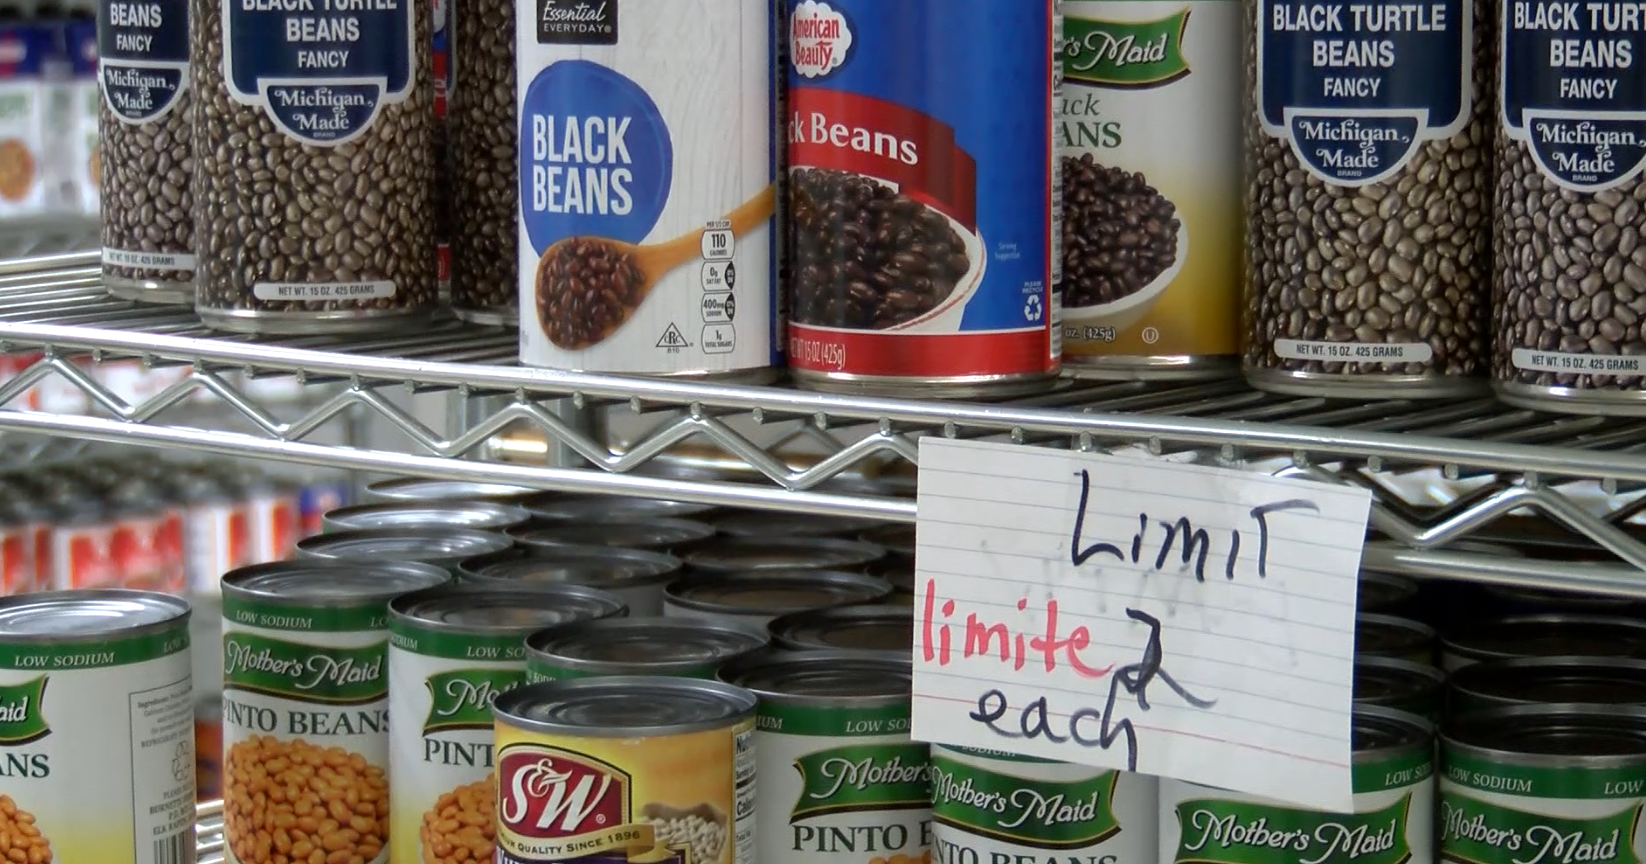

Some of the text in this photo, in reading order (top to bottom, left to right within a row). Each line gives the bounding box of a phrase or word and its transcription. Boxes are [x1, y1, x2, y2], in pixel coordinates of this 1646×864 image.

[110, 3, 161, 28] BEANS
[543, 1, 607, 22] Essential
[1273, 4, 1447, 31] BLACK TURTLE
[1514, 2, 1579, 30] BLACK
[286, 18, 360, 41] BEANS
[793, 12, 840, 39] American
[117, 34, 152, 52] FANCY
[795, 41, 833, 70] Beauty
[1073, 31, 1168, 71] Maid
[1313, 40, 1395, 67] BEANS
[1550, 39, 1632, 68] BEANS
[298, 51, 349, 68] FANCY
[106, 68, 175, 96] Michigan
[1324, 78, 1381, 98] FANCY
[1560, 78, 1618, 99] FANCY
[114, 92, 153, 110] Made
[274, 87, 374, 113] Michigan
[293, 113, 349, 130] Made
[533, 114, 634, 165] BLACK
[811, 112, 918, 166] Beans
[1299, 120, 1409, 151] Michigan
[1536, 121, 1646, 152] Michigan
[1316, 146, 1379, 169] Made
[1552, 150, 1615, 173] Made
[533, 165, 635, 216] BEANS
[711, 233, 726, 248] 110
[278, 287, 292, 296] NET
[310, 286, 319, 296] 15
[335, 286, 348, 295] 425
[349, 285, 375, 295] GRAMS
[1083, 326, 1116, 342] (425g)
[821, 342, 846, 370] (425g)
[1296, 344, 1310, 354] NET
[1311, 345, 1325, 355] WT.
[1328, 345, 1337, 356] 15
[1355, 346, 1371, 357] 425
[1372, 346, 1403, 357] GRAMS
[1532, 354, 1545, 365] NET
[1546, 355, 1560, 368] WT.
[1562, 356, 1571, 368] 15
[1589, 358, 1605, 370] 425
[1606, 359, 1639, 372] GRAMS
[236, 610, 312, 629] LOW SODIUM
[922, 577, 1116, 680] limite
[15, 652, 115, 668] LOW SODIUM
[226, 640, 382, 689] Mother's Maid
[466, 646, 501, 659] LOW
[845, 720, 882, 732] LOW
[969, 662, 1138, 772] each
[1385, 768, 1413, 786] LOW
[1450, 765, 1532, 793] LOW SODIUM
[1605, 780, 1643, 795] LOW
[932, 766, 1098, 828] Mother's Maid
[518, 842, 562, 855] QUALITY
[566, 838, 603, 852] SINCE
[608, 830, 641, 843] 1896
[791, 823, 908, 853] PINTO
[1185, 809, 1396, 864] Mother's Maid
[1442, 801, 1620, 864] Mother's Maid
